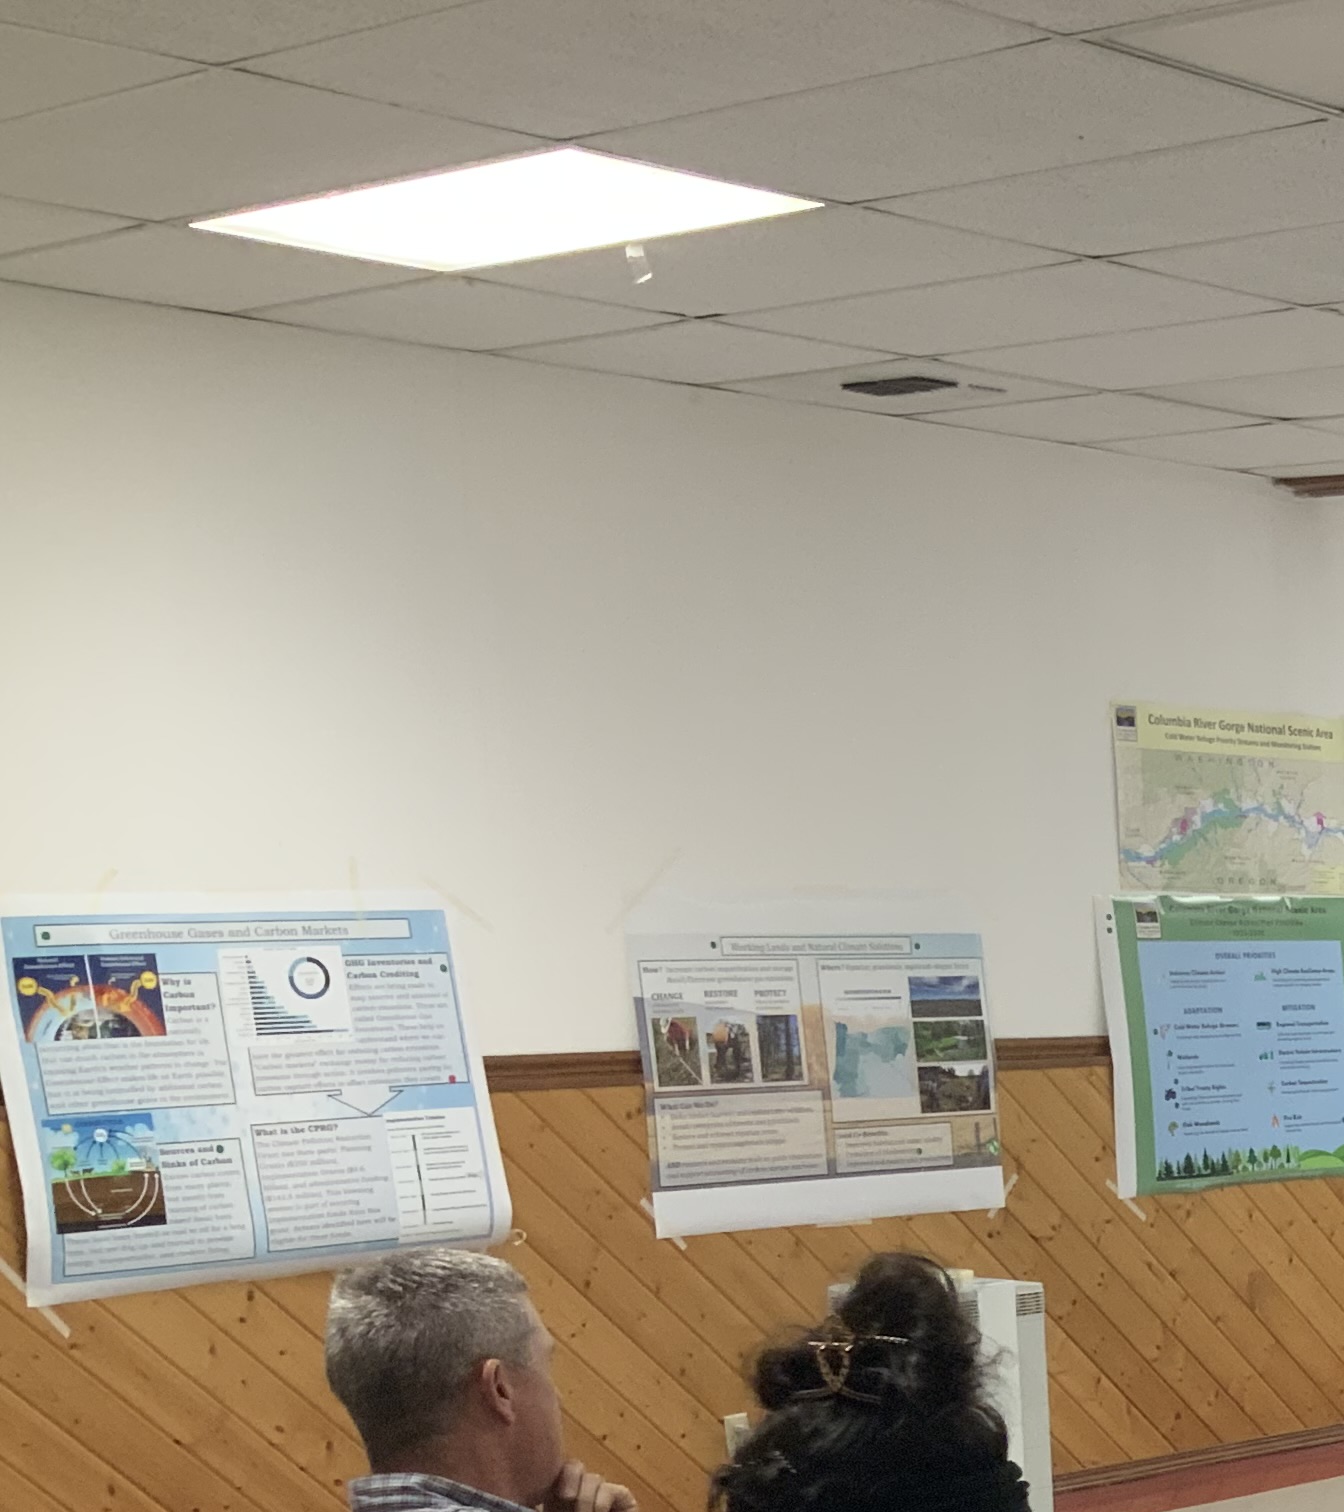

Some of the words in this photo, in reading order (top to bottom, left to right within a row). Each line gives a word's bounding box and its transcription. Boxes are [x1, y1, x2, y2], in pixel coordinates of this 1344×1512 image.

[1149, 714, 1191, 728] Columbia
[1194, 718, 1216, 730] River
[1219, 720, 1245, 734] Gorge
[1248, 722, 1285, 735] National
[1288, 726, 1313, 737] Scenic
[1316, 728, 1333, 740] Area
[109, 927, 184, 941] Greenhouse
[188, 927, 224, 939] Gases
[229, 927, 250, 938] and
[254, 925, 297, 937] Carbon
[301, 925, 349, 936] Markets
[162, 978, 181, 988] Why
[163, 990, 195, 999] Carbon
[651, 992, 684, 1001] CHANGE
[704, 989, 738, 998] RESTORE
[754, 989, 787, 998] PROTECT
